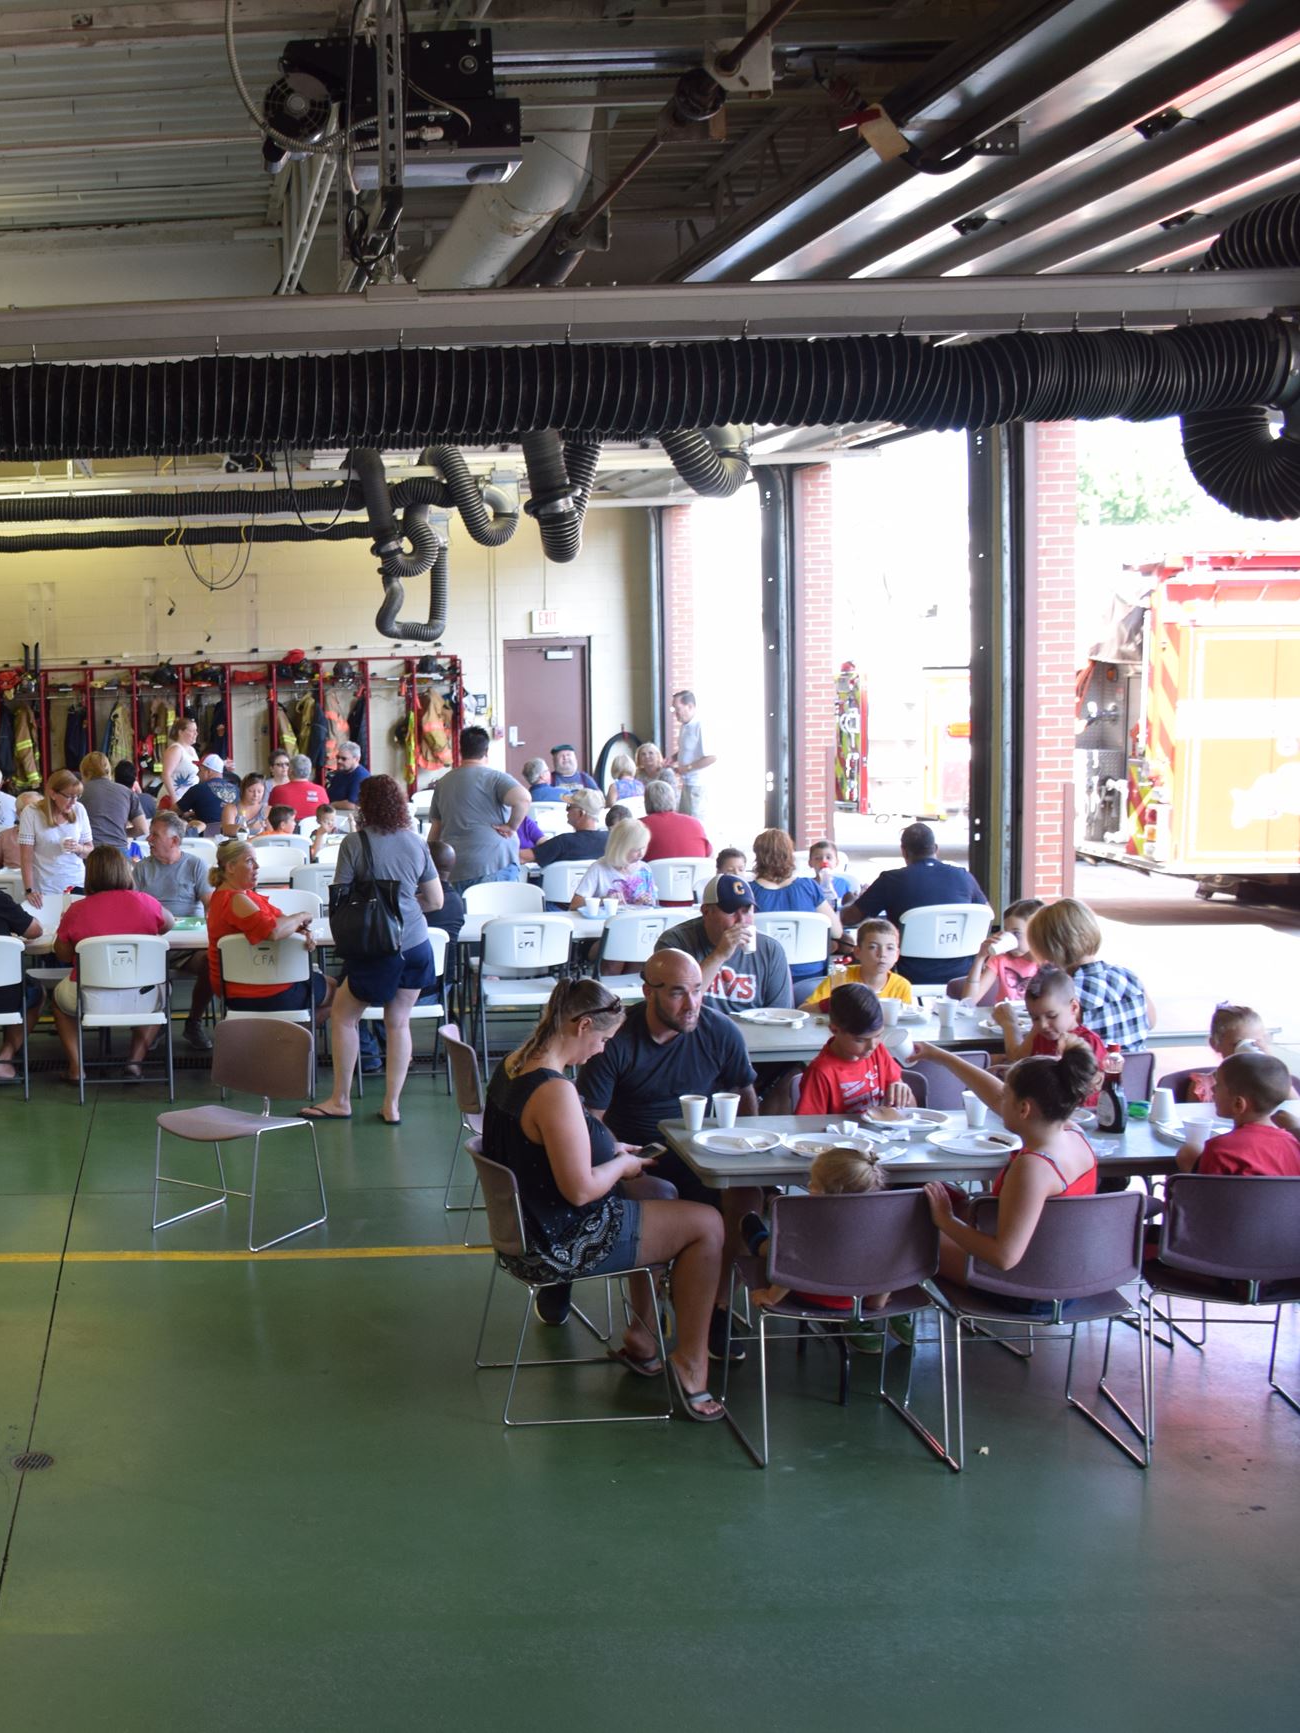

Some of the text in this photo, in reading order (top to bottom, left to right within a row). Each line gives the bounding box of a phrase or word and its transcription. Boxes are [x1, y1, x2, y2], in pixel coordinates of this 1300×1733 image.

[538, 611, 557, 626] EXIT
[733, 881, 745, 895] C
[938, 933, 958, 945] CFA
[112, 956, 133, 967] CFA
[252, 954, 275, 967] CFA
